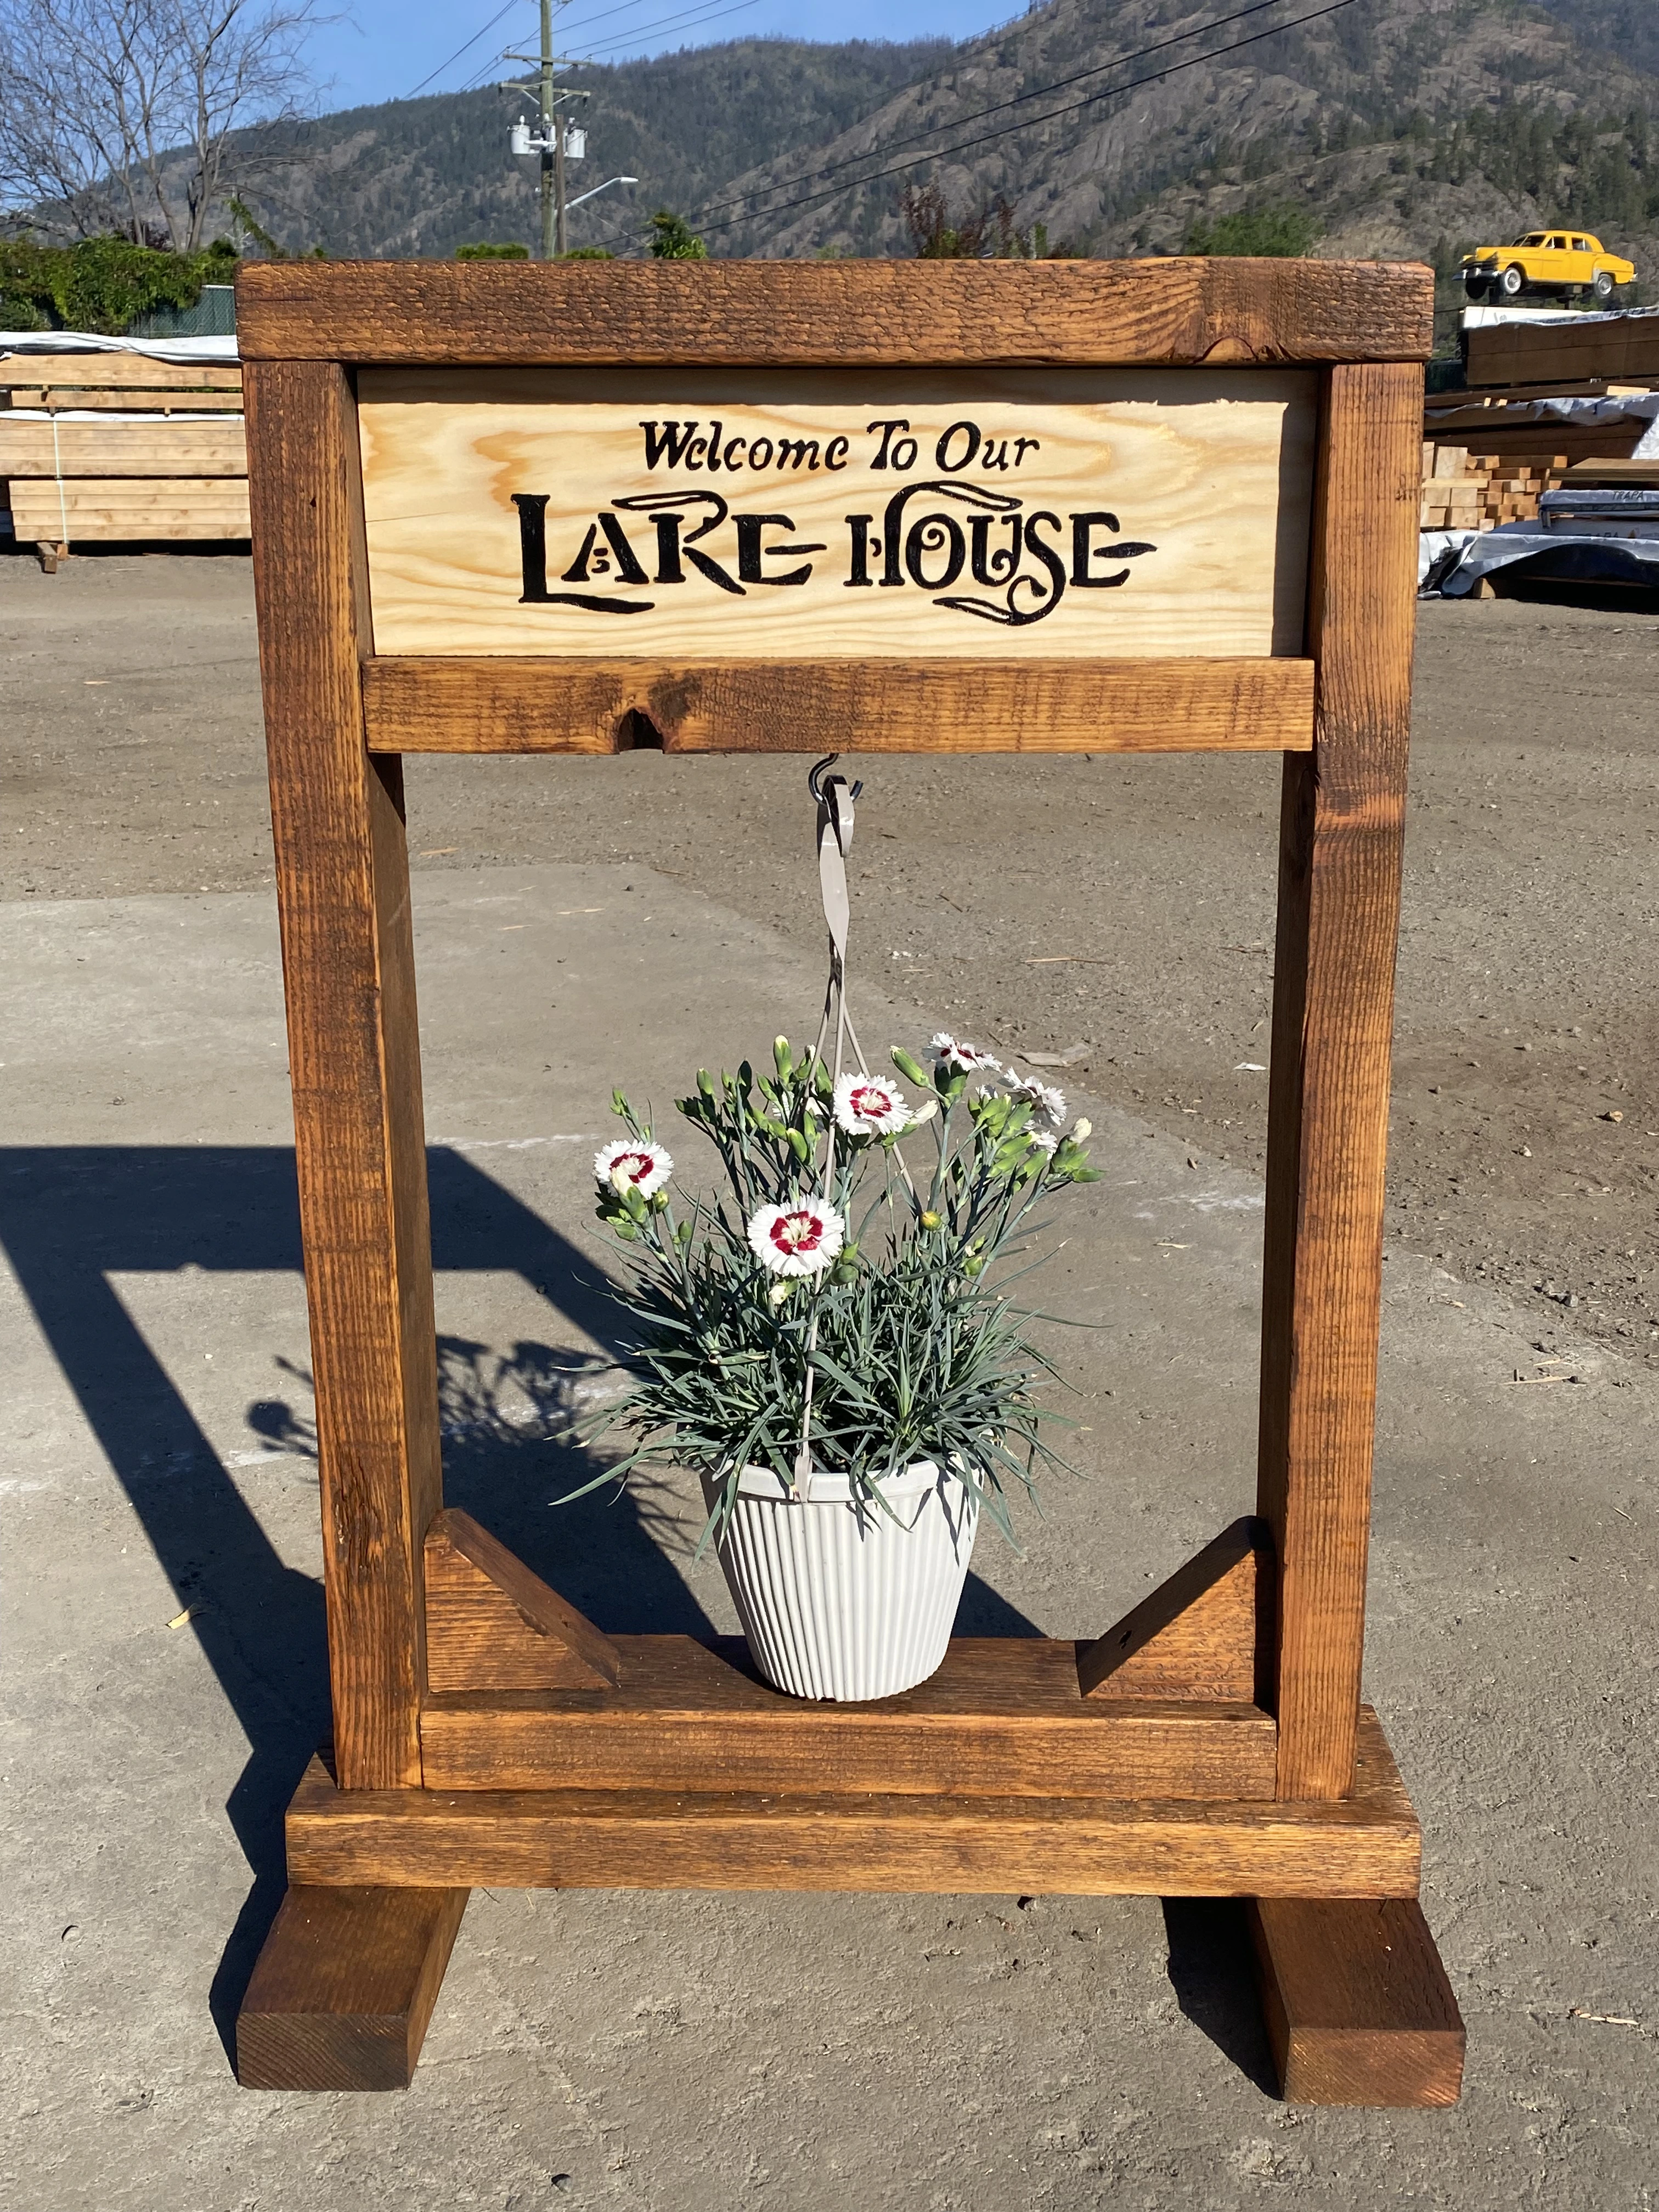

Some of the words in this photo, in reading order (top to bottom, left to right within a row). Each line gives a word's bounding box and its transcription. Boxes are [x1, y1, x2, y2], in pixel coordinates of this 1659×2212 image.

[639, 420, 848, 471] Welcome
[867, 420, 917, 470] To
[936, 422, 1040, 472] Our
[1612, 491, 1644, 500] TRAPA
[511, 490, 827, 614] LAKE
[843, 481, 1156, 626] HOUSE
